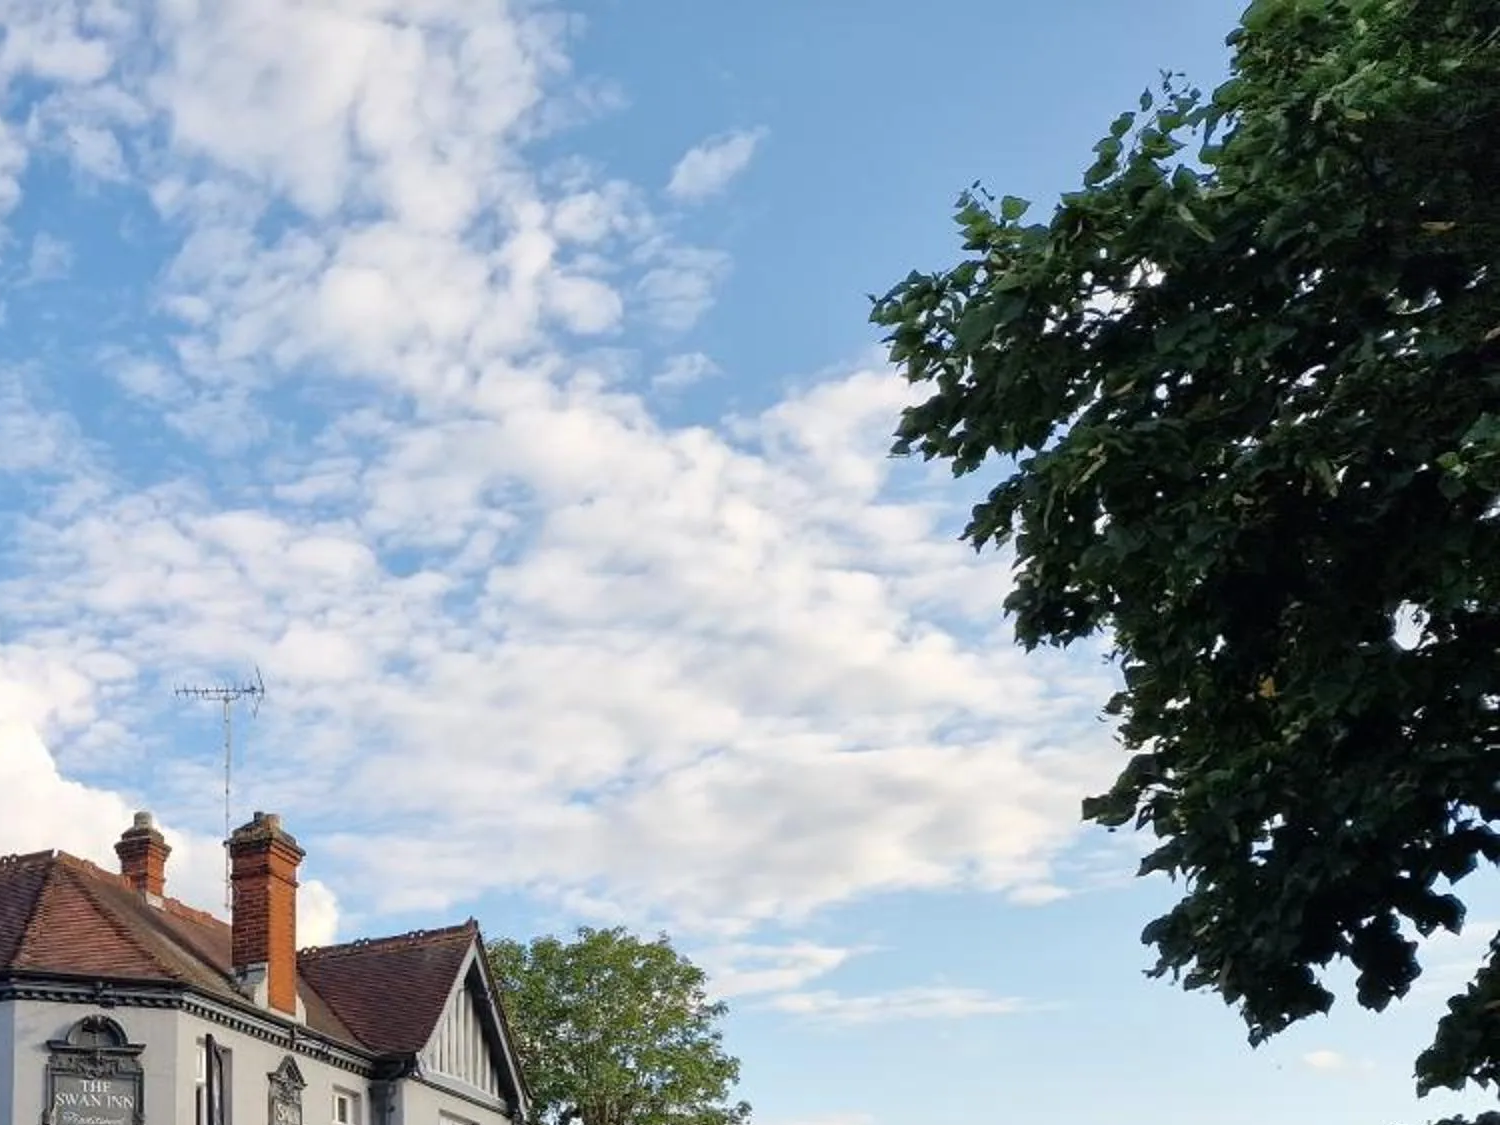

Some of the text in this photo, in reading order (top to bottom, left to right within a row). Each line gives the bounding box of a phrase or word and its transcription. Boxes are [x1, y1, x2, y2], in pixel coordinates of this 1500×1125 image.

[80, 1079, 112, 1093] THE
[55, 1092, 134, 1109] SWAN INN
